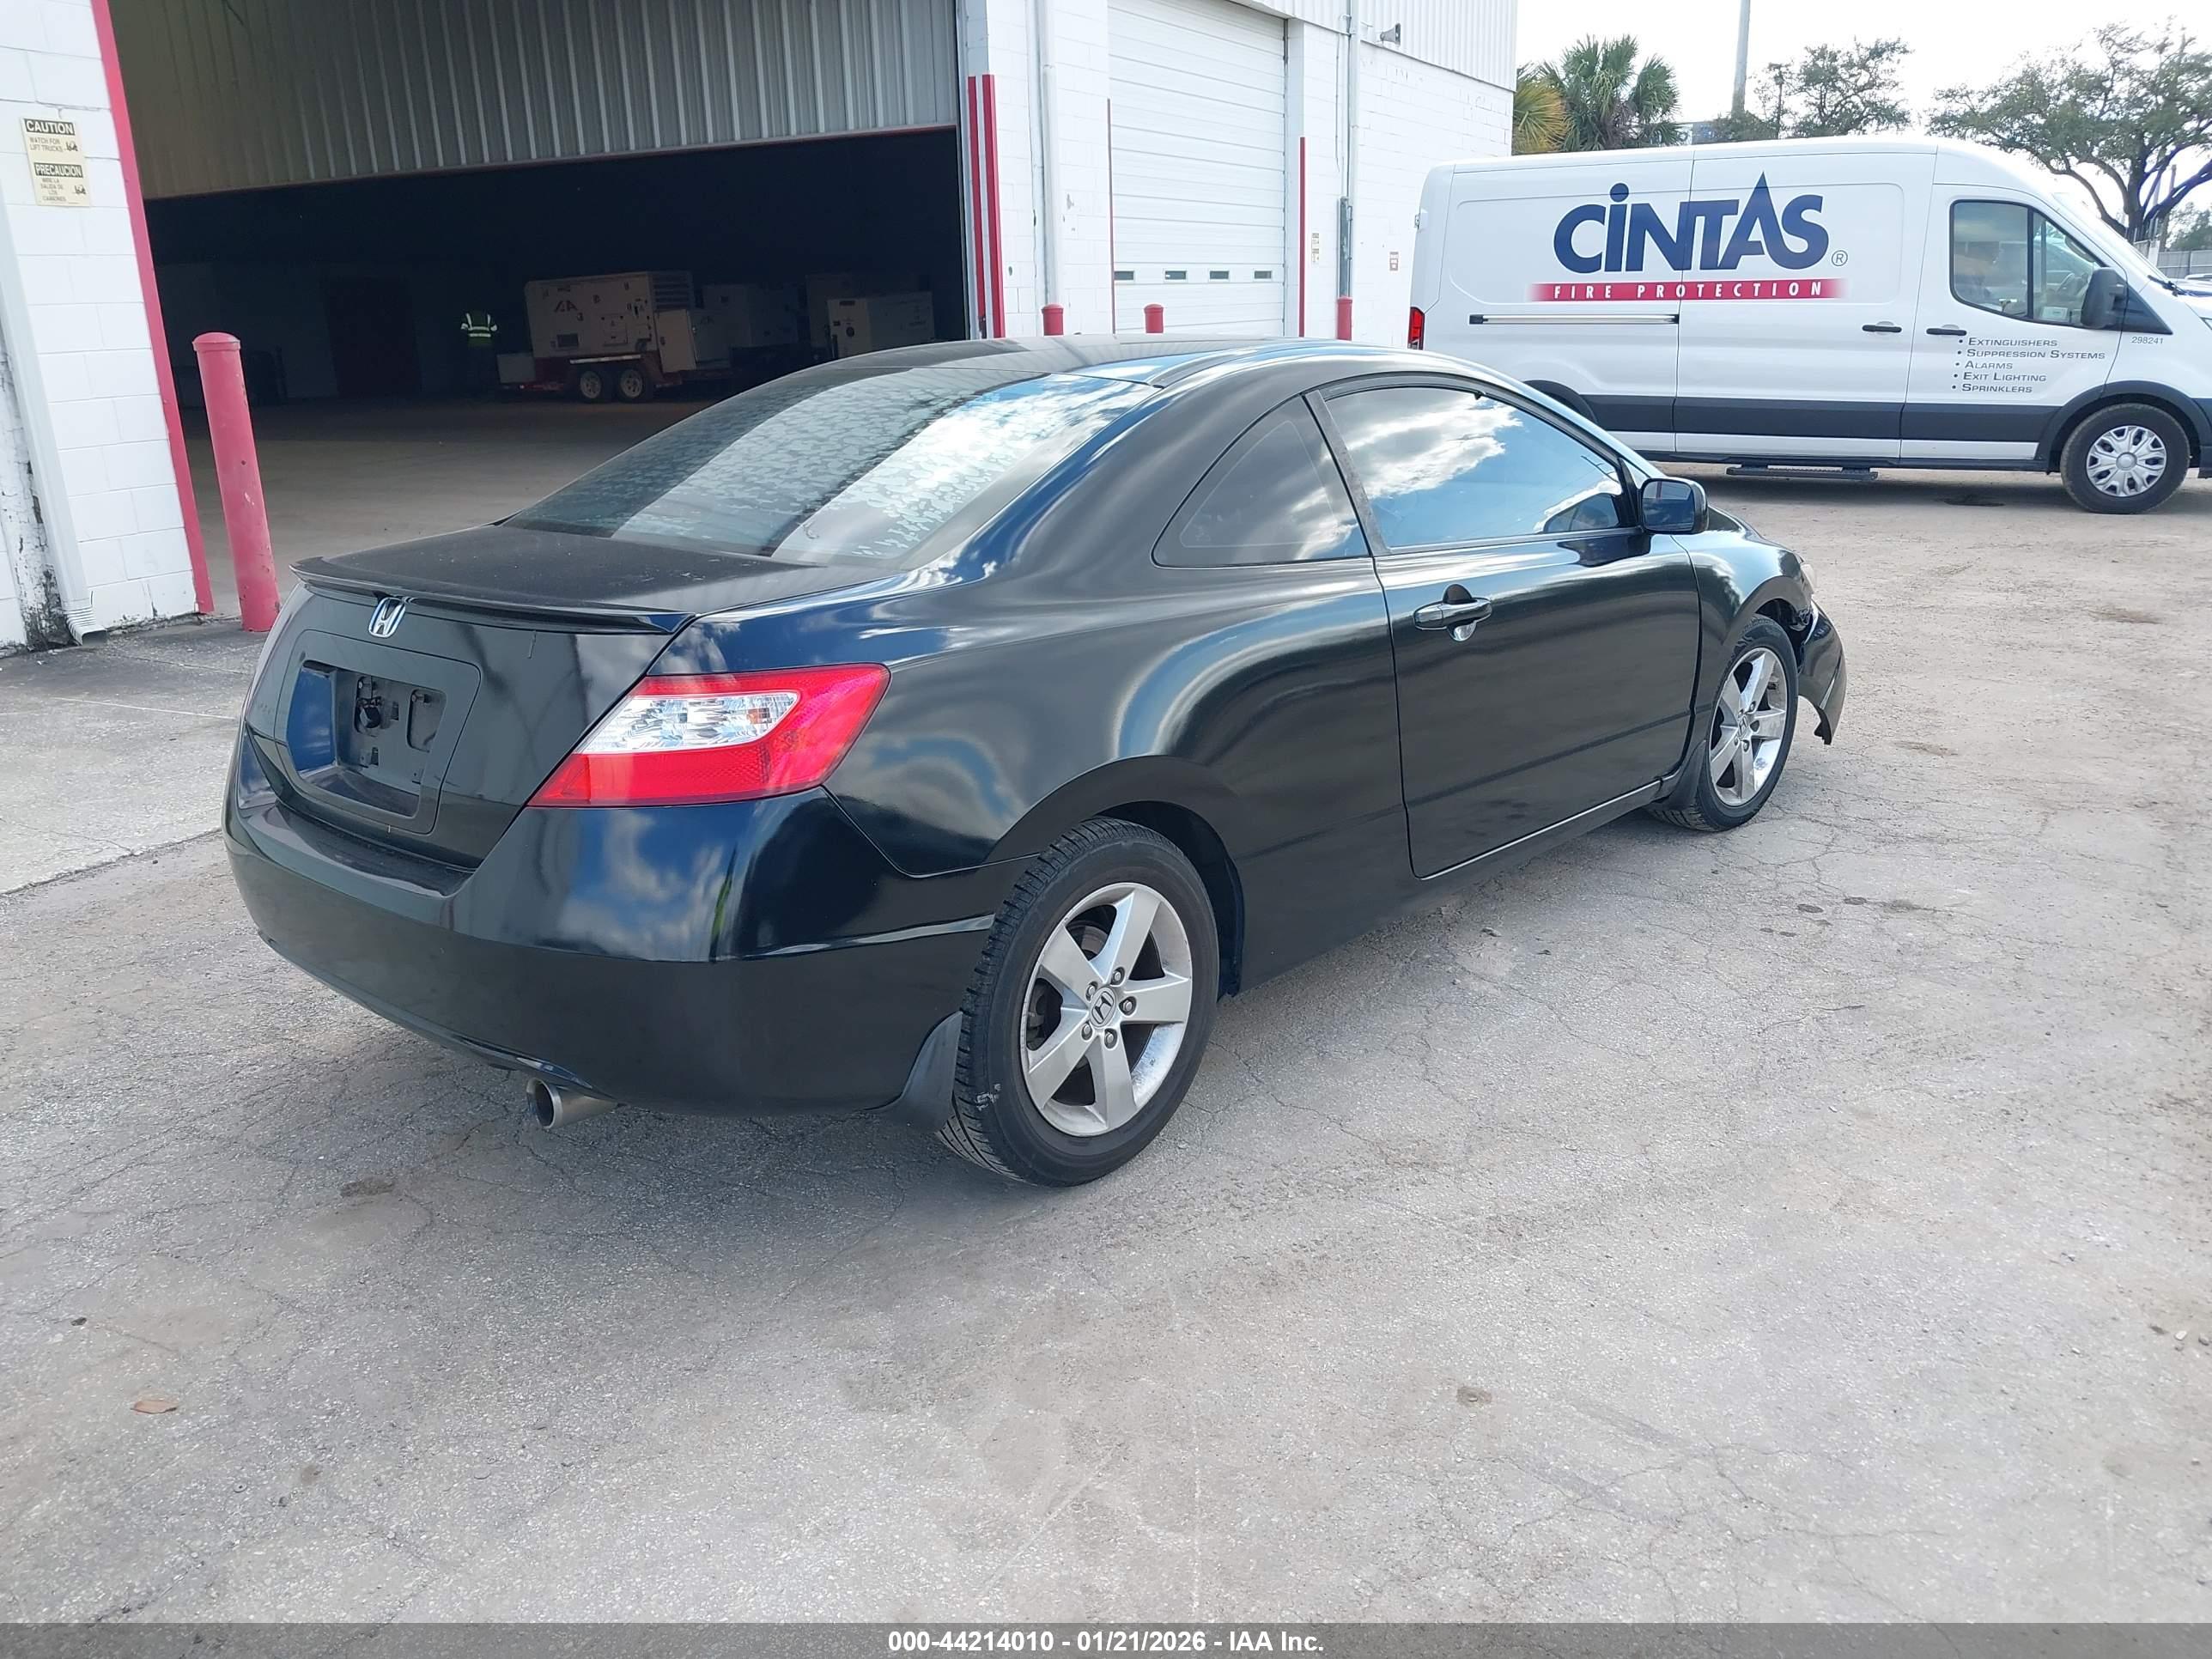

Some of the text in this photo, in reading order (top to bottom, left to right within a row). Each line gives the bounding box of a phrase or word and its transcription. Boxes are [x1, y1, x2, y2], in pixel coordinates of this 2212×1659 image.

[27, 120, 74, 134] CAUTION
[36, 164, 82, 177] PRECAUCION
[1554, 281, 1822, 300] FIRE PROTECTION
[2131, 336, 2164, 344] 298241
